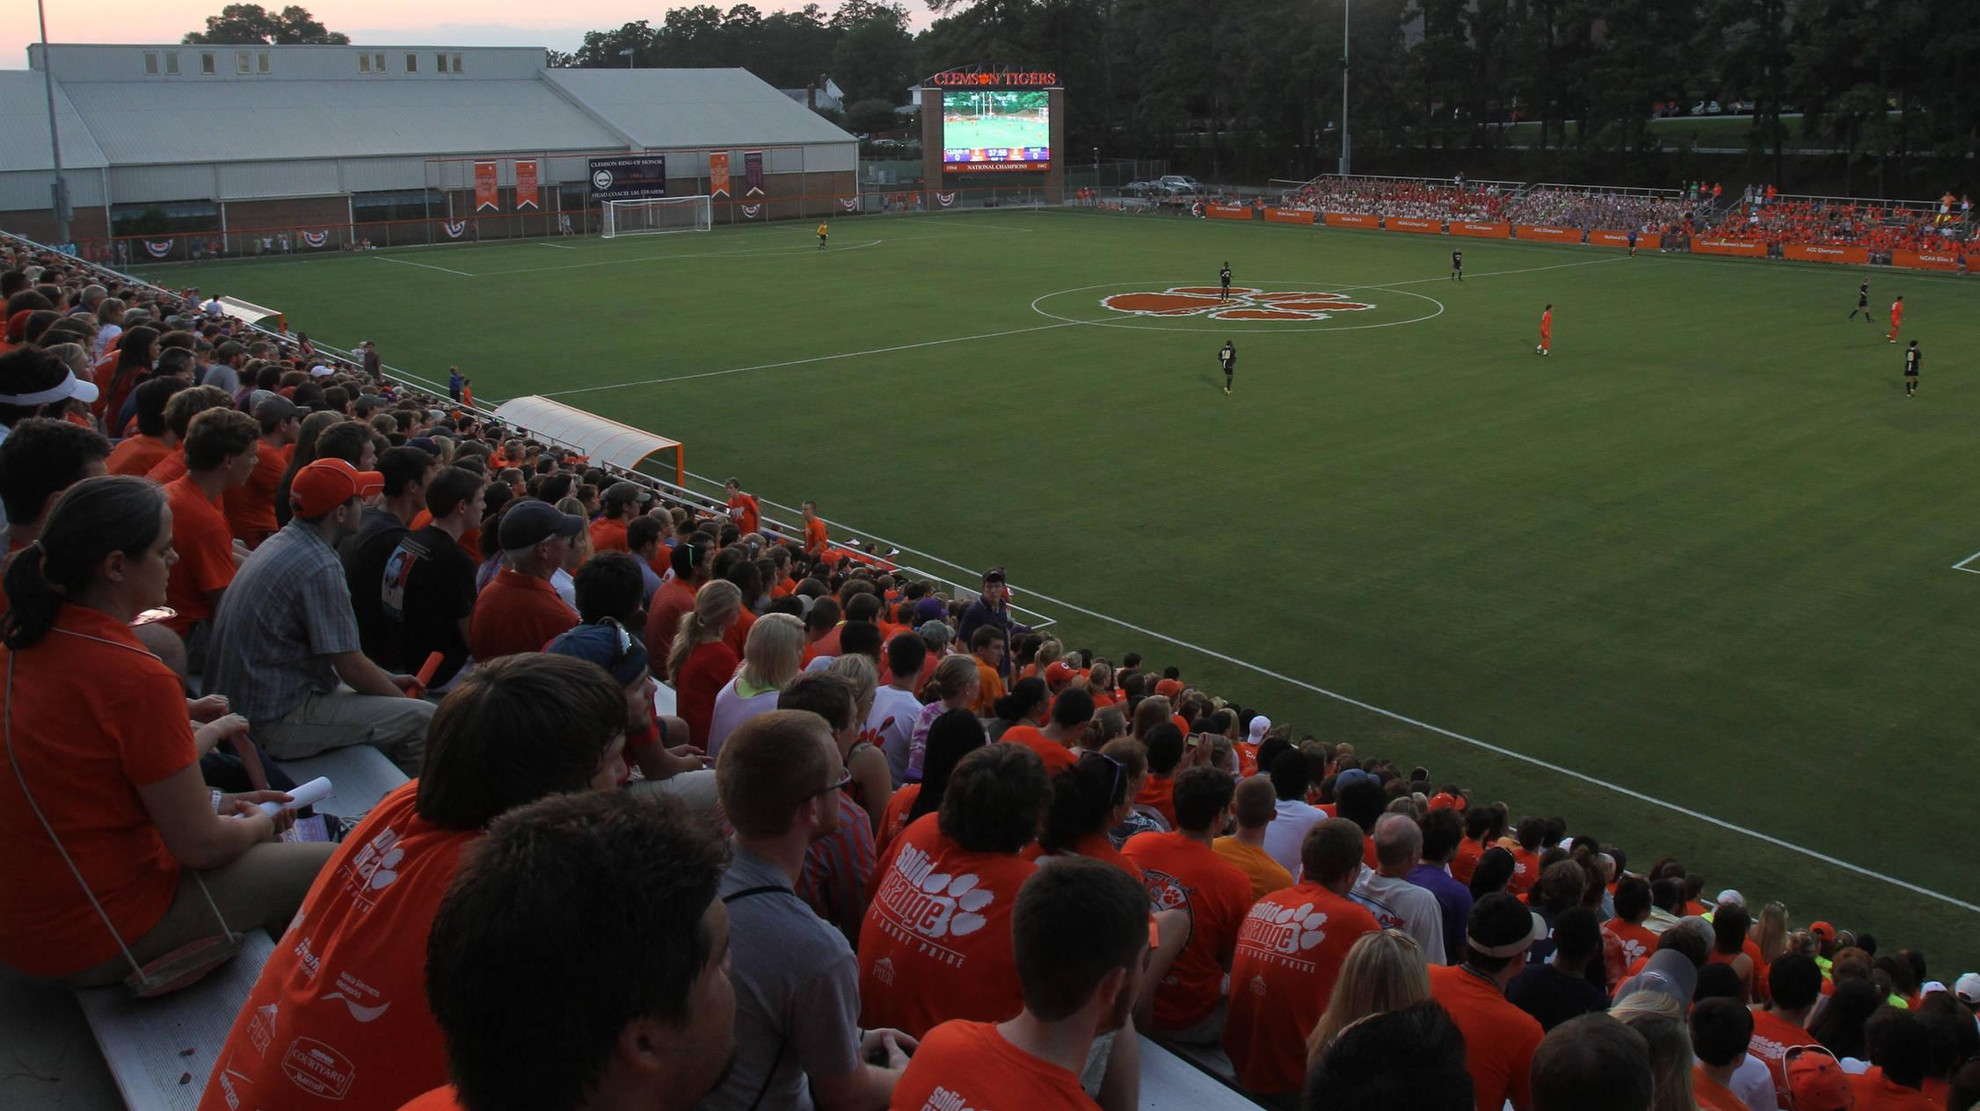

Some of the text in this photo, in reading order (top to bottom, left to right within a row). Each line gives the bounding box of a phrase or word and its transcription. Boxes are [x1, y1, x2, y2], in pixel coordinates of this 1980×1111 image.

[1003, 72, 1056, 85] TIGERS
[918, 942, 964, 968] PRIDE
[292, 1049, 345, 1083] COURTYARD
